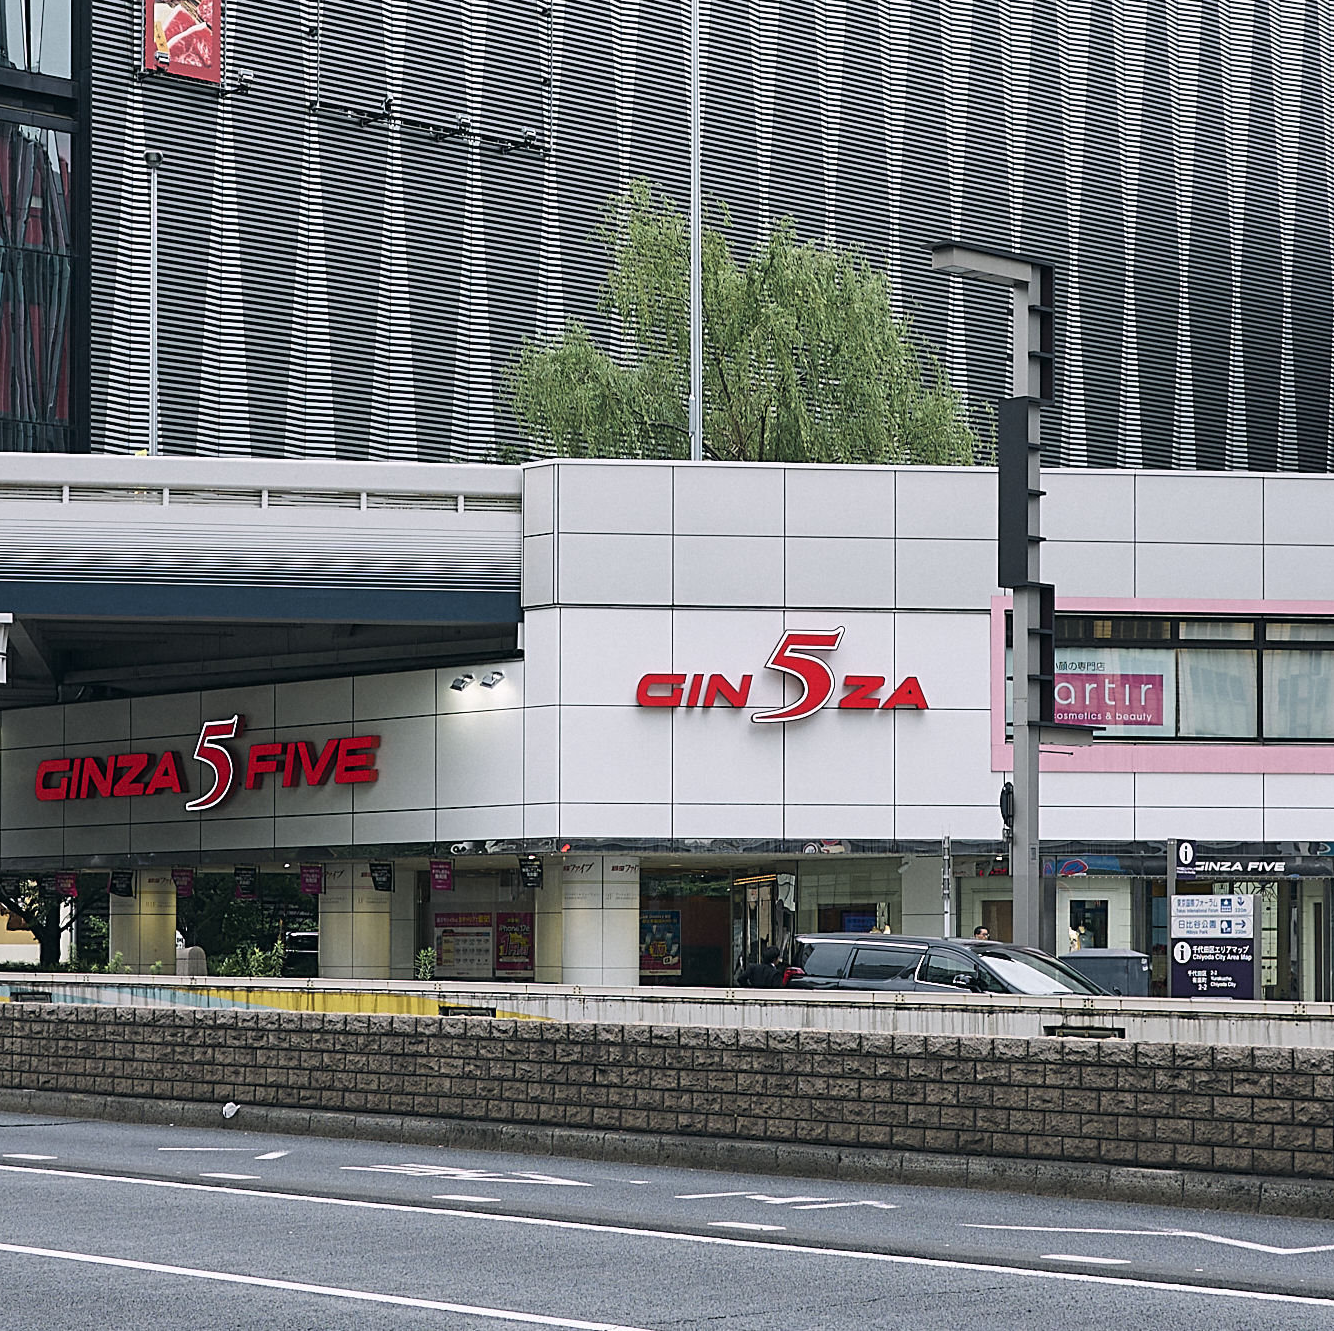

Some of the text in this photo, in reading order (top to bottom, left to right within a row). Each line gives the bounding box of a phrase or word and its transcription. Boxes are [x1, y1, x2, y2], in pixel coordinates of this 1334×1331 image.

[1054, 712, 1152, 722] osmetics & beauty
[35, 714, 381, 812] GINZA 5 FIVE
[1247, 861, 1286, 872] FIVE
[1176, 898, 1218, 908] 東京国際フォーラム
[1179, 920, 1217, 929] 日比谷公園
[1192, 945, 1250, 954] 千代田区エリアマップ
